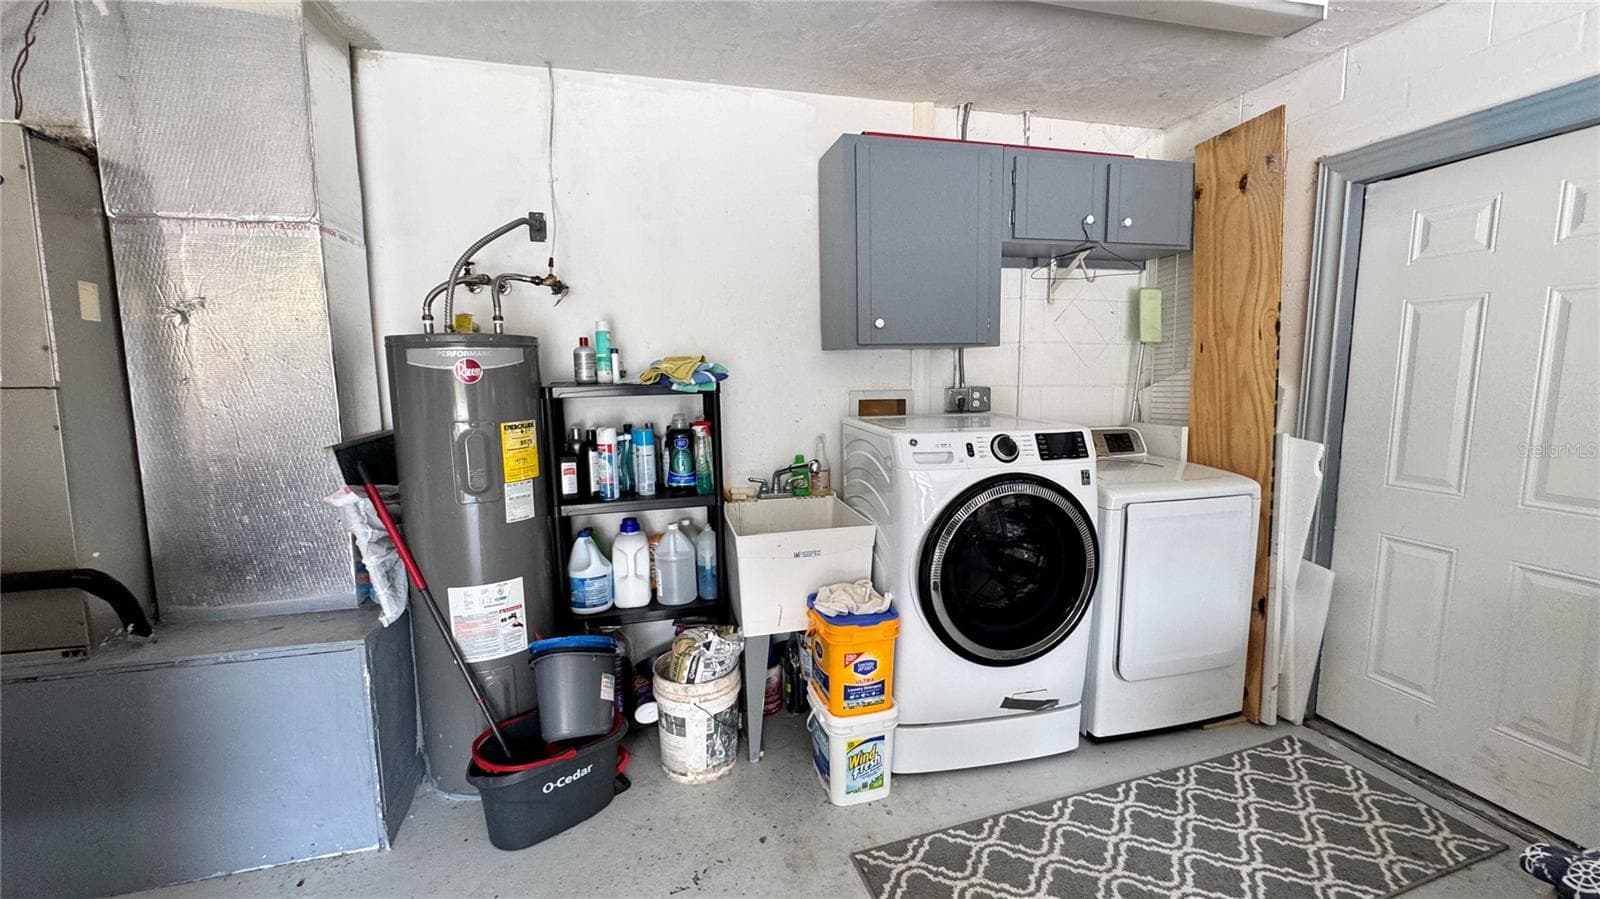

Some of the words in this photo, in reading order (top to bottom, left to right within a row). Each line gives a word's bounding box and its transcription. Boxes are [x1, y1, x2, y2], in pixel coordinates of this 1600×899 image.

[855, 677, 875, 685] ULTRA
[848, 743, 878, 771] Wind
[542, 763, 594, 794] O-Cedar
